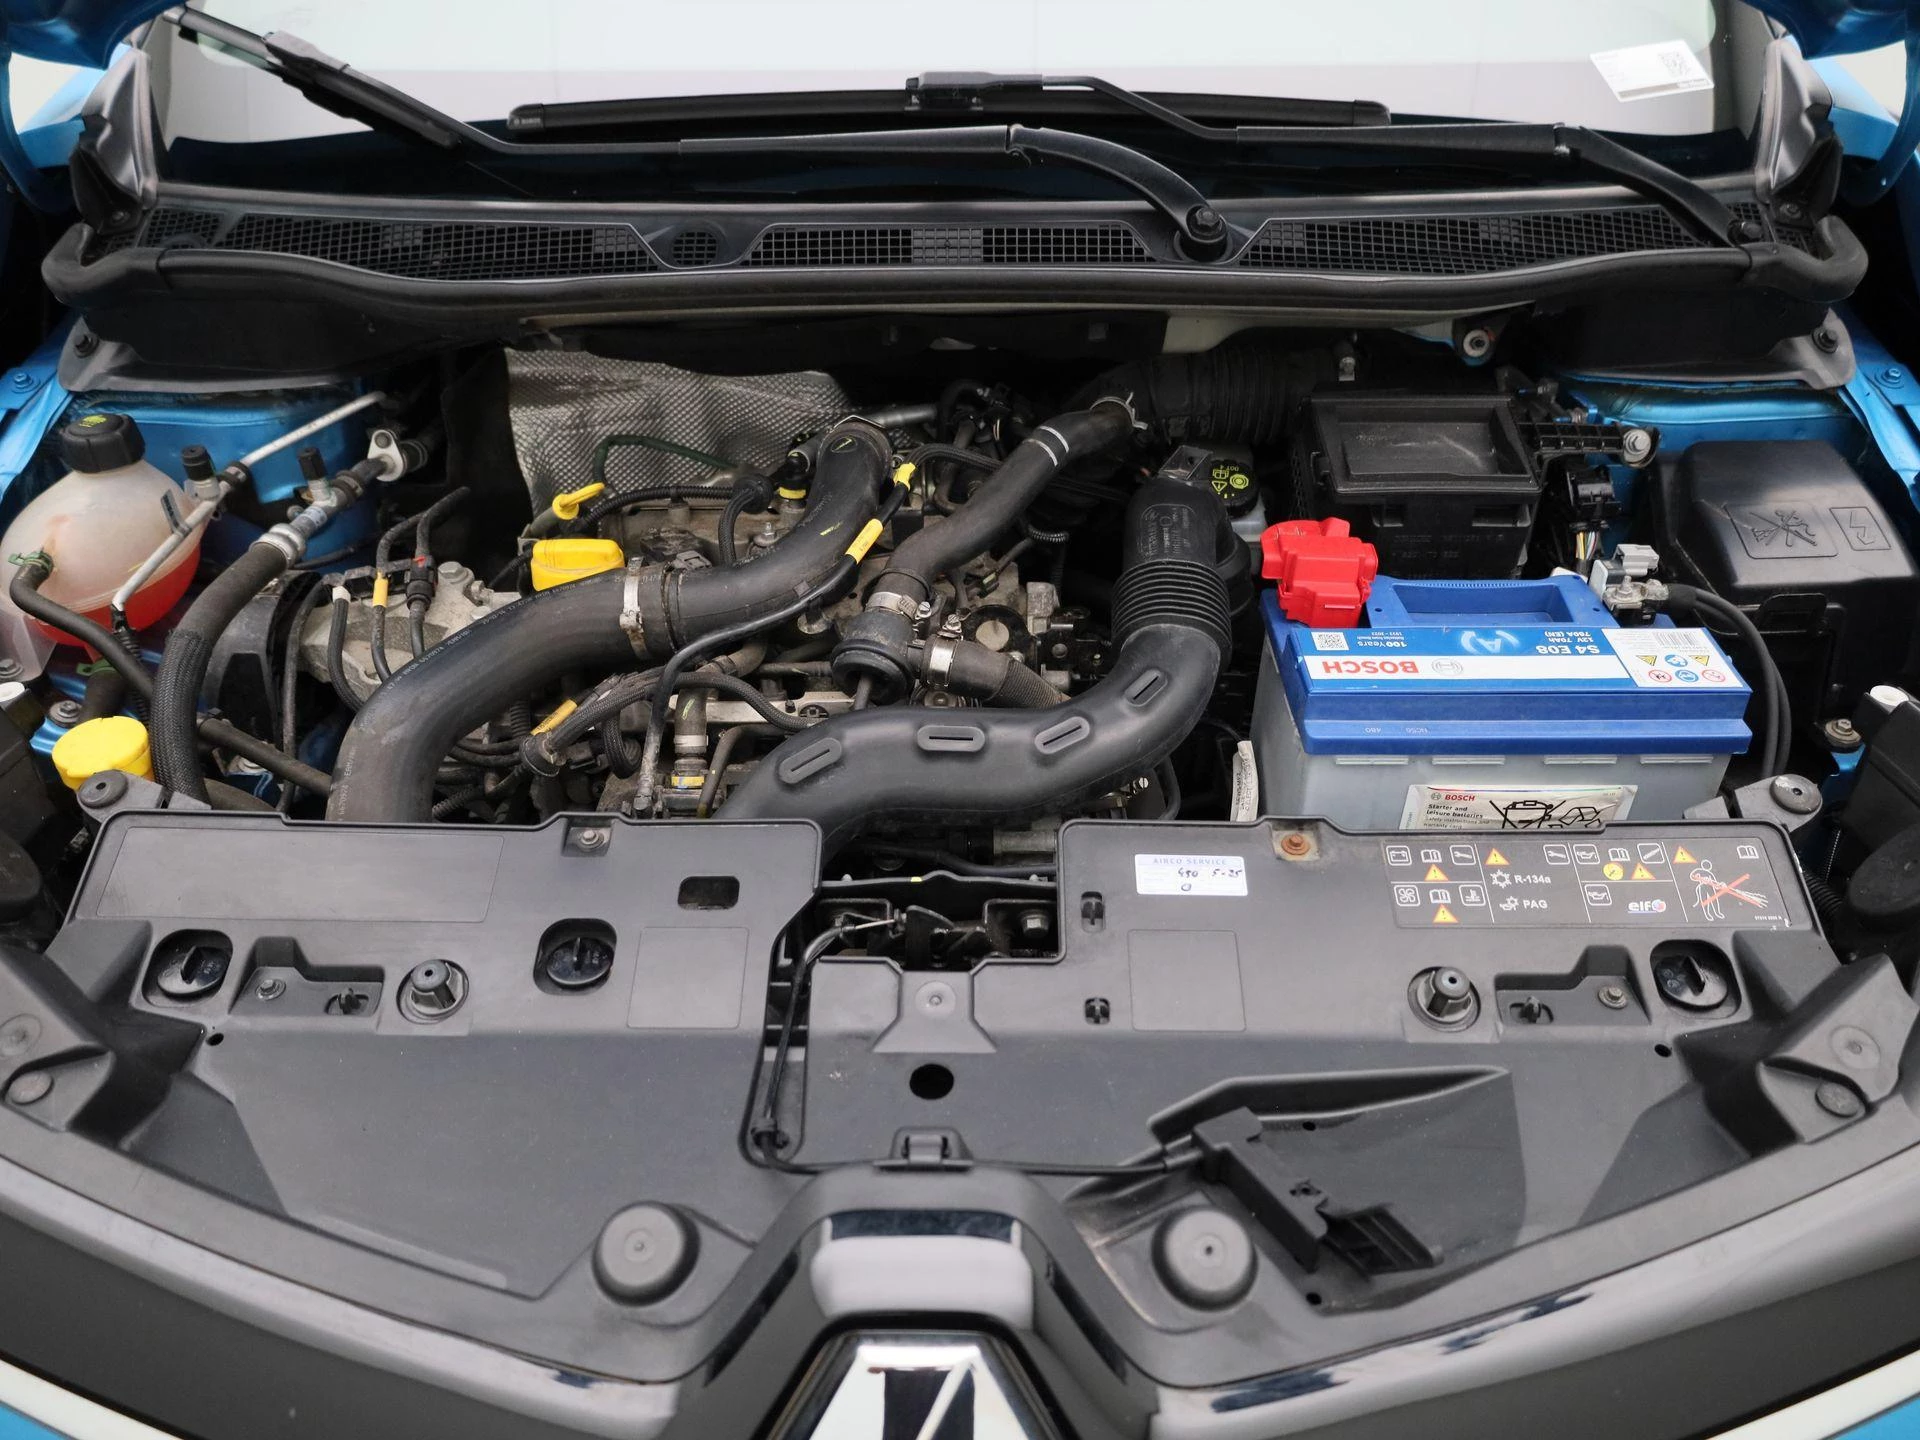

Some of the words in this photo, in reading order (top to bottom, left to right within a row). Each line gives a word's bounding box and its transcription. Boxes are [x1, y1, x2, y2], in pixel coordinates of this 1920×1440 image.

[1535, 645, 1572, 654] E08
[1575, 645, 1600, 654] S4
[1322, 660, 1420, 674] BOSCH
[1444, 794, 1476, 802] BOSCH
[1451, 811, 1484, 819] batteries
[1153, 857, 1183, 865] AIRCO
[1513, 874, 1552, 884] R-134a
[1522, 899, 1548, 909] PAG
